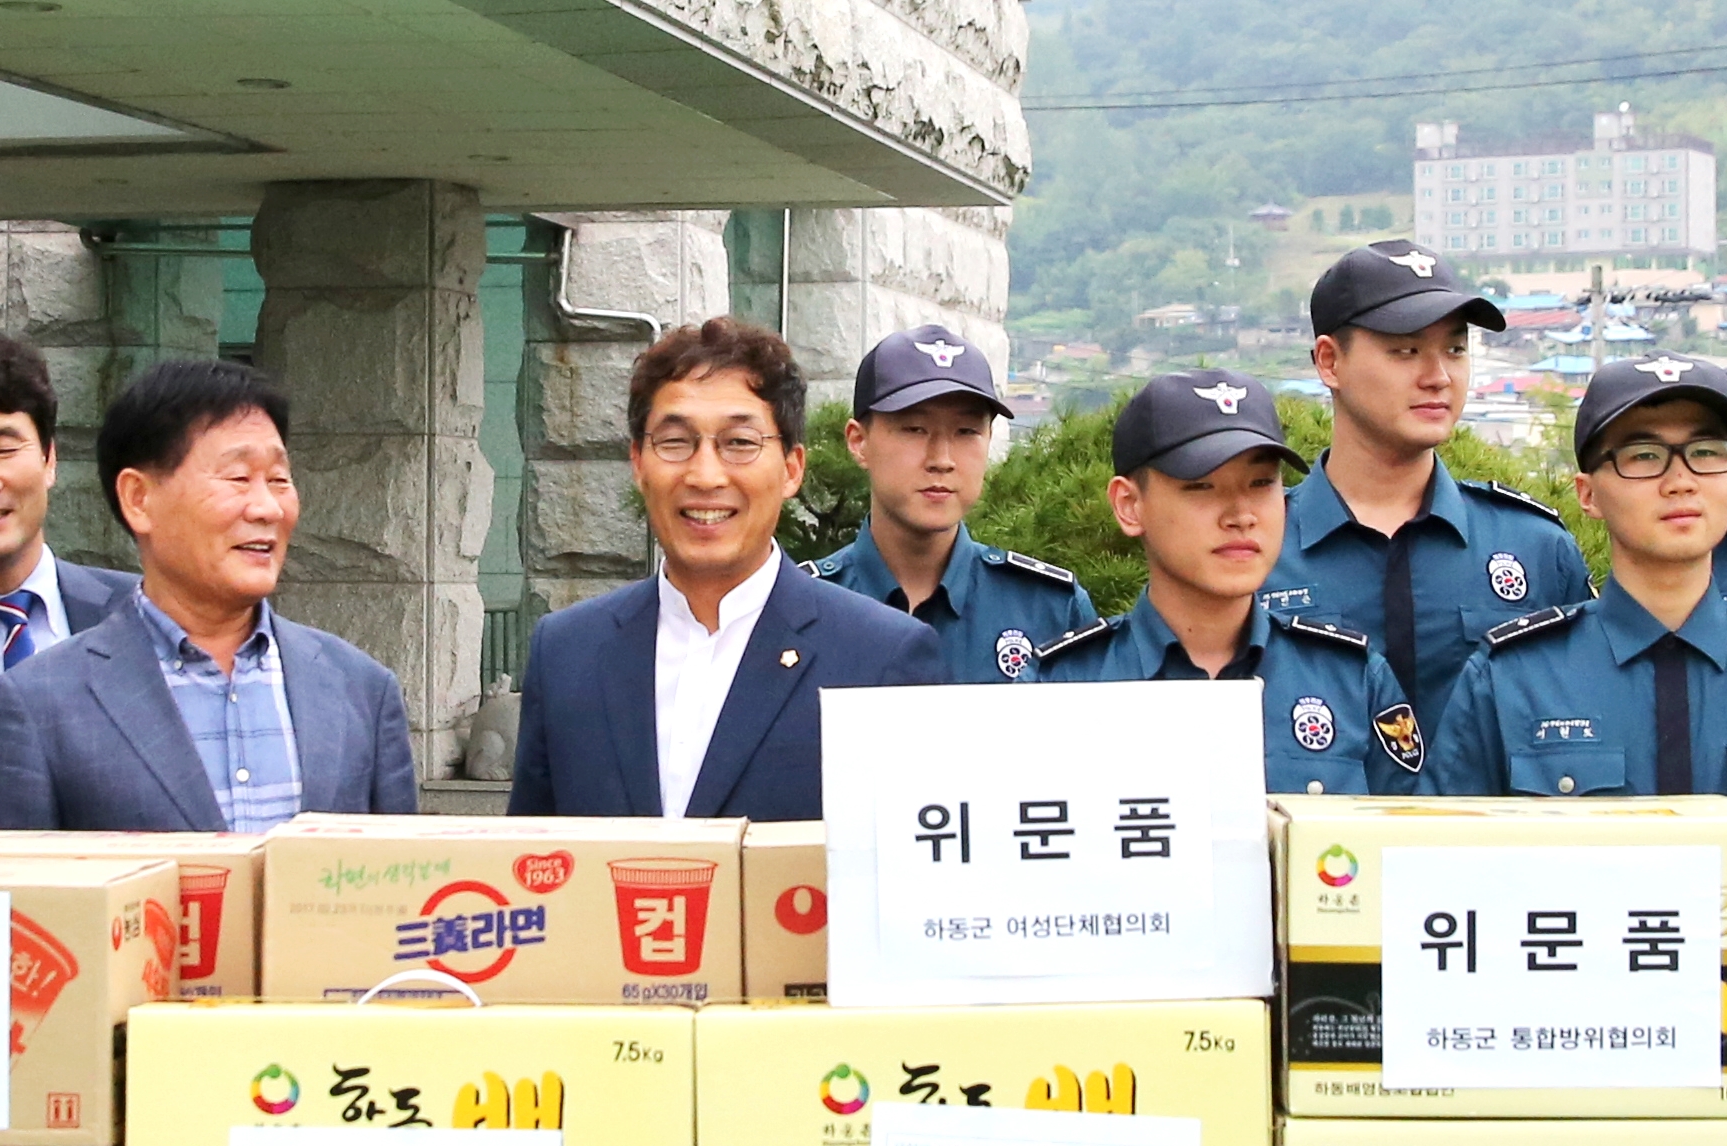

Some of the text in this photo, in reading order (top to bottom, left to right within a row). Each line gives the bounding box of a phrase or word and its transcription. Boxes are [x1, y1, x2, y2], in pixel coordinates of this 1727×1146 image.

[525, 857, 562, 871] Since
[523, 868, 564, 887] 1963
[633, 893, 688, 965] 컵
[923, 911, 1170, 941] 하동군 여성단체협의회
[1426, 1026, 1676, 1051] 하동군 통합방위협의회
